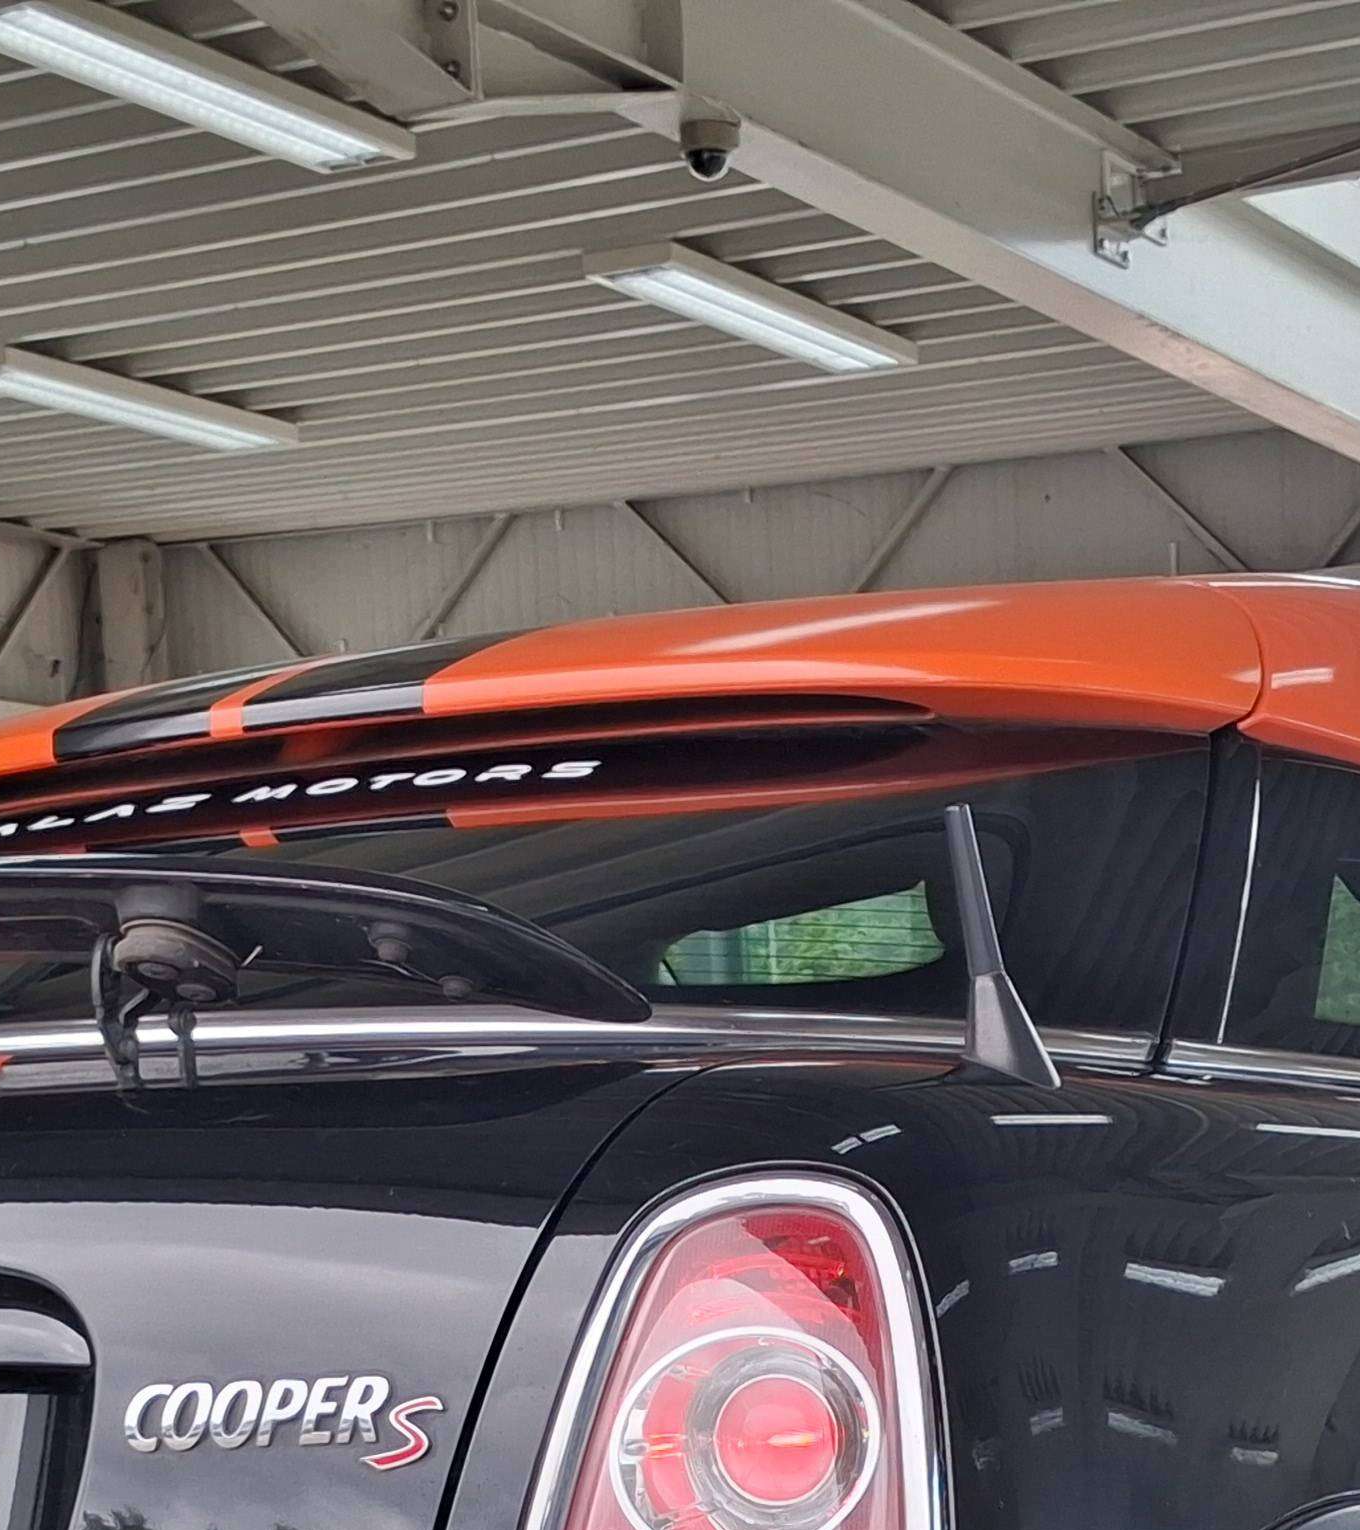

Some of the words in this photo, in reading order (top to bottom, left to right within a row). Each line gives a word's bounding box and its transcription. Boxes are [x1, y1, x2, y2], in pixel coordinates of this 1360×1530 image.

[232, 759, 603, 804] MOTORS
[124, 1374, 390, 1452] COOPER
[360, 1396, 444, 1471] S
